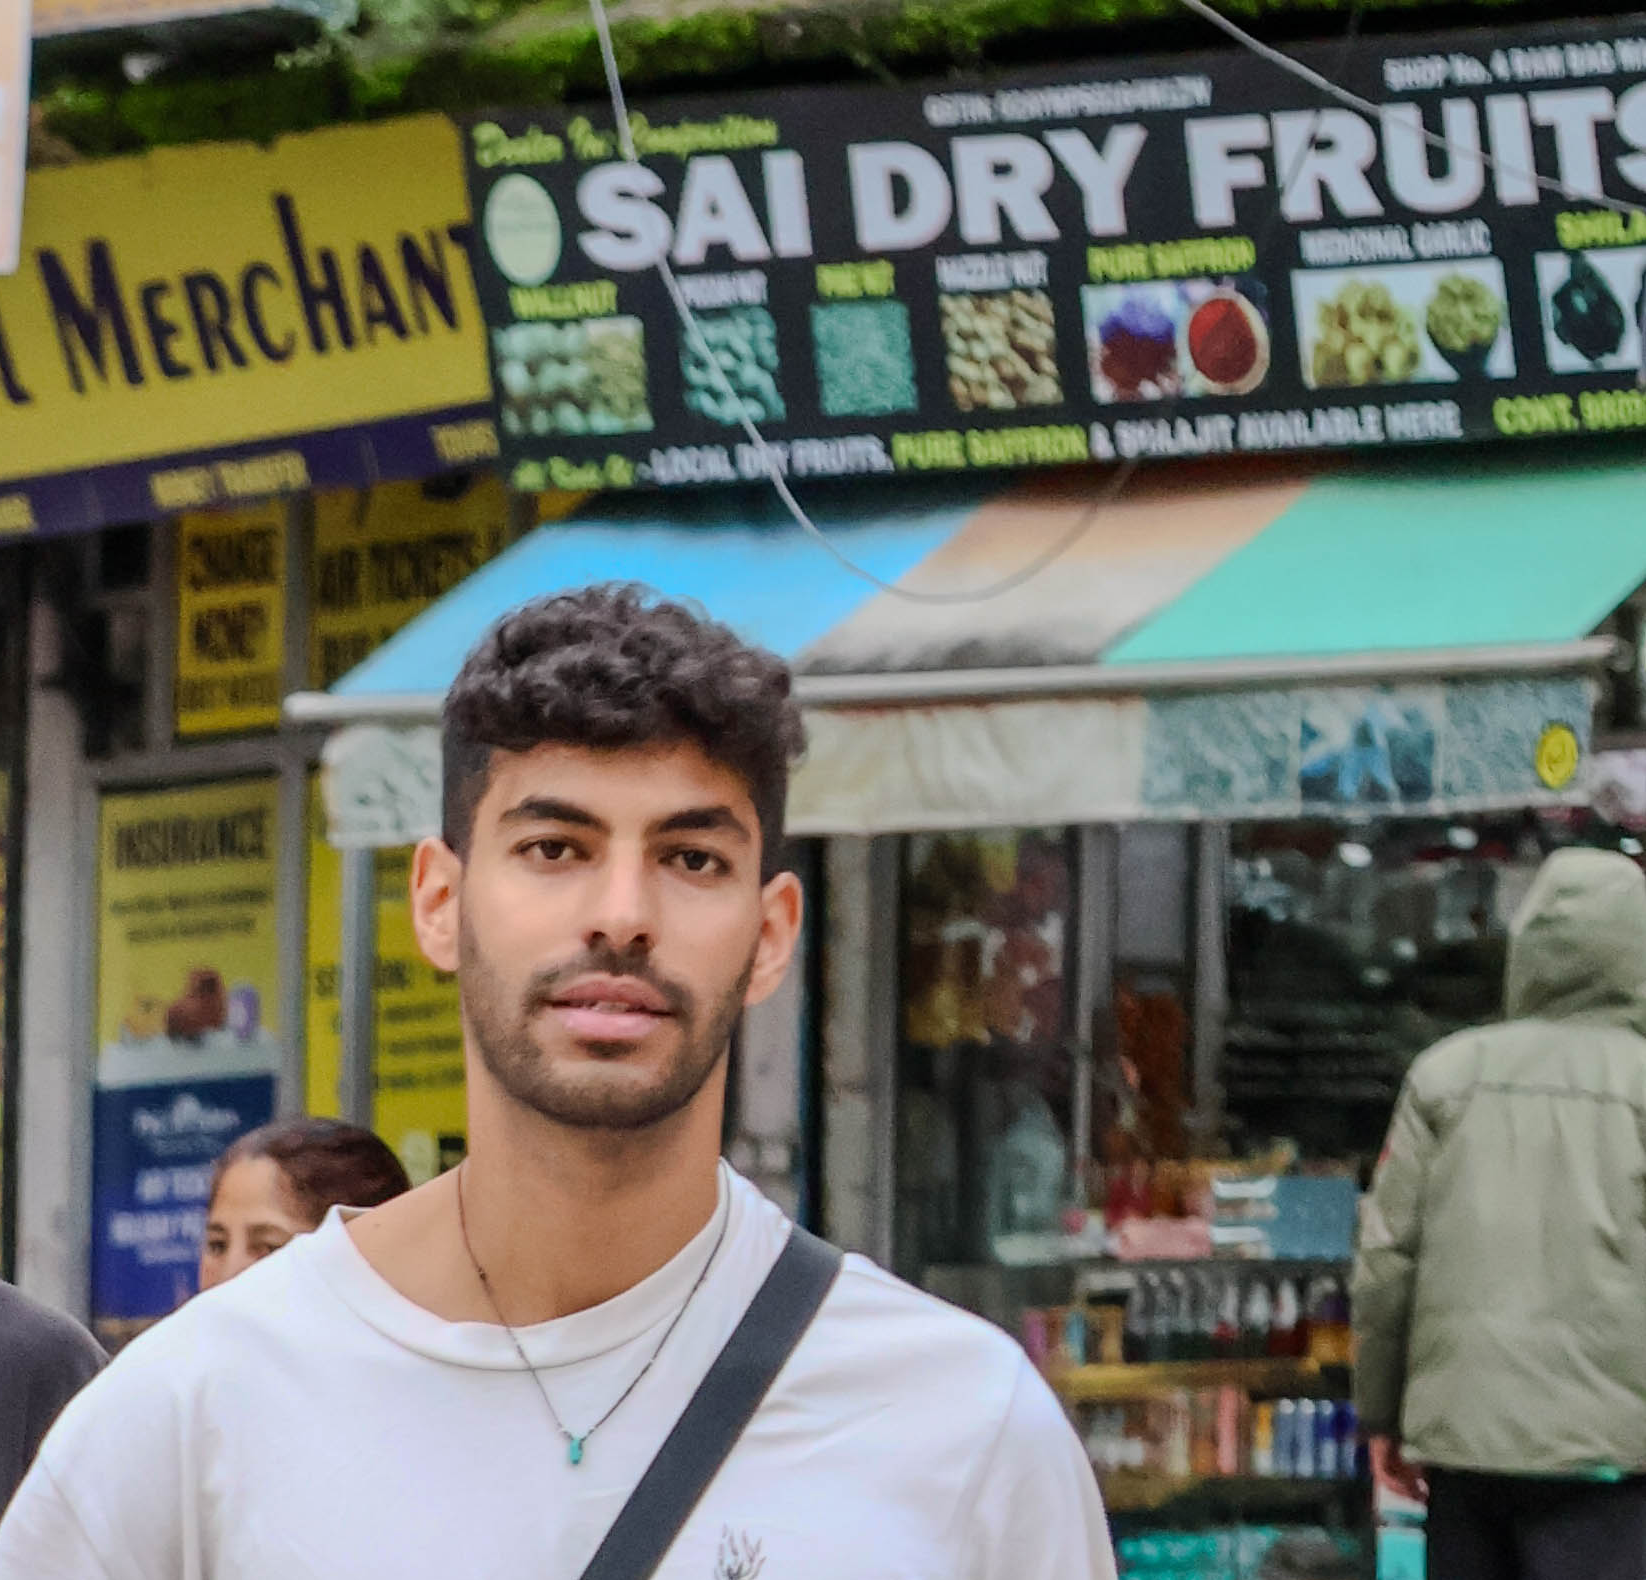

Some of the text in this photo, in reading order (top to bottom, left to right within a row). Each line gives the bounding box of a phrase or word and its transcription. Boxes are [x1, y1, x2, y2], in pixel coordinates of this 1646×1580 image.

[1383, 54, 1449, 92] SHOP
[578, 150, 813, 273] SAI
[847, 124, 1149, 254] DRY
[1238, 404, 1386, 451] AVAILABLE
[1384, 399, 1463, 441] HERE
[116, 808, 267, 869] INSURANCE
